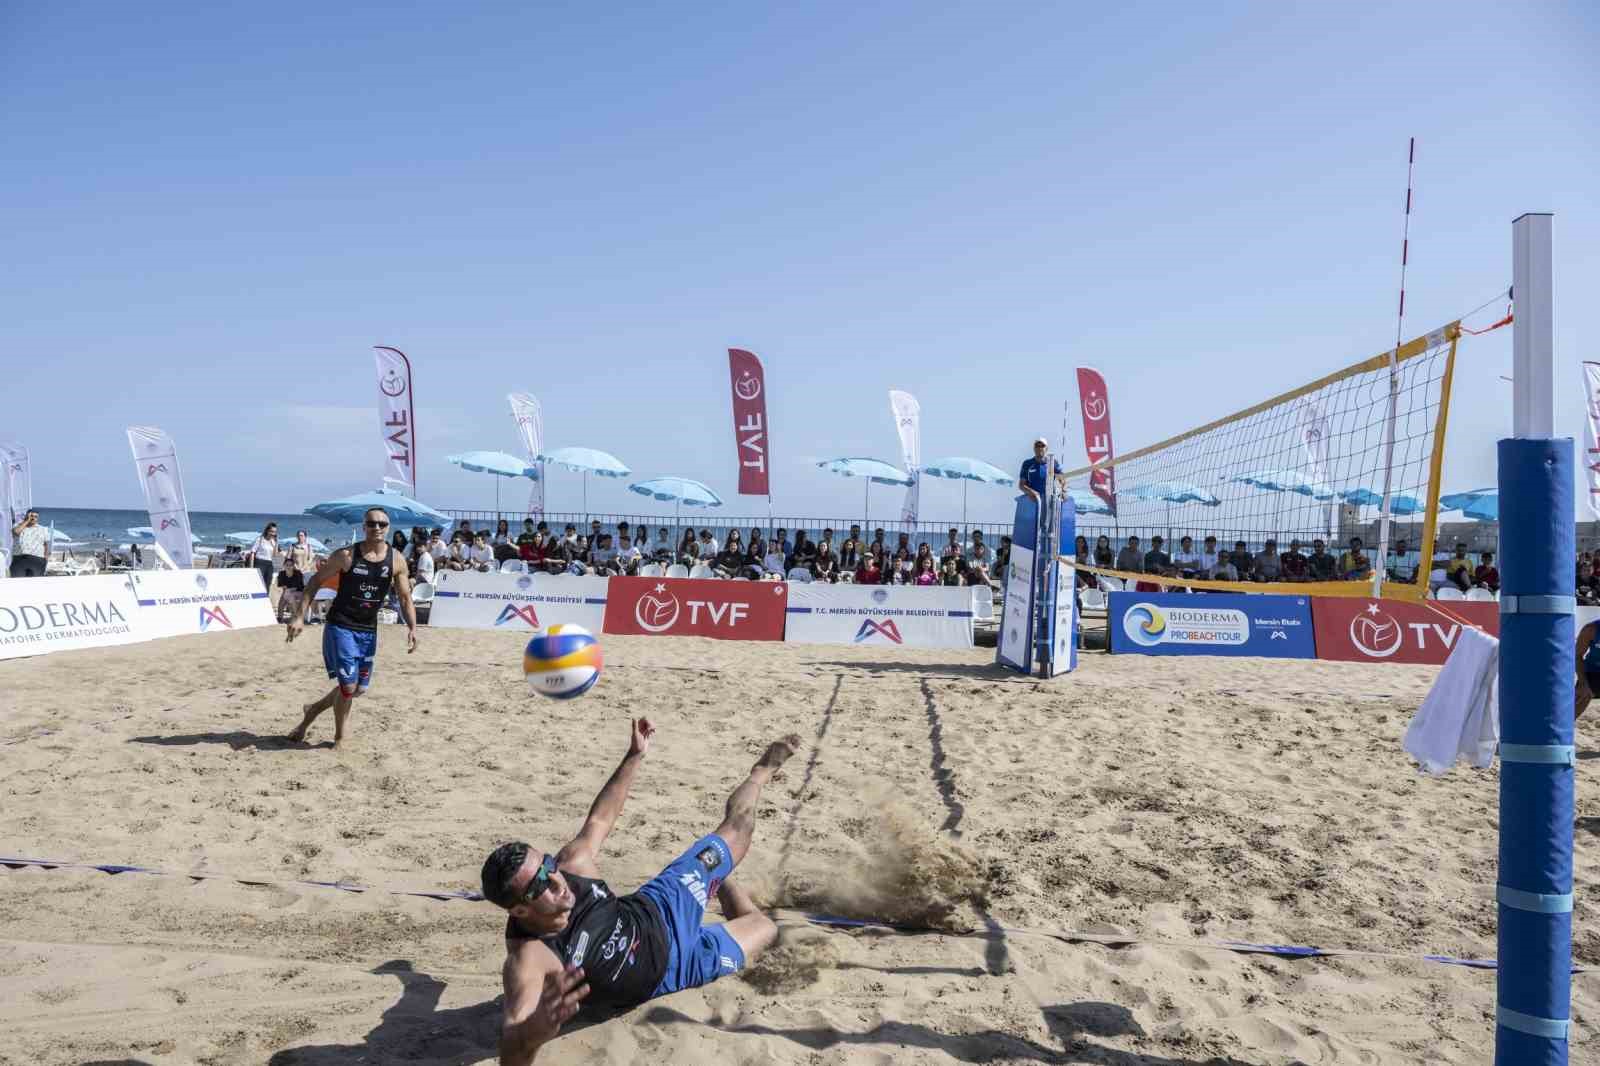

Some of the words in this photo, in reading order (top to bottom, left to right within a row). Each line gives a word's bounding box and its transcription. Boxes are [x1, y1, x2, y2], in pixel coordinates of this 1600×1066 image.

[381, 566, 390, 577] 2
[686, 600, 750, 627] TVF
[829, 606, 857, 616] MERSİN
[1169, 611, 1240, 623] BIODERMA
[1408, 623, 1482, 650] TV
